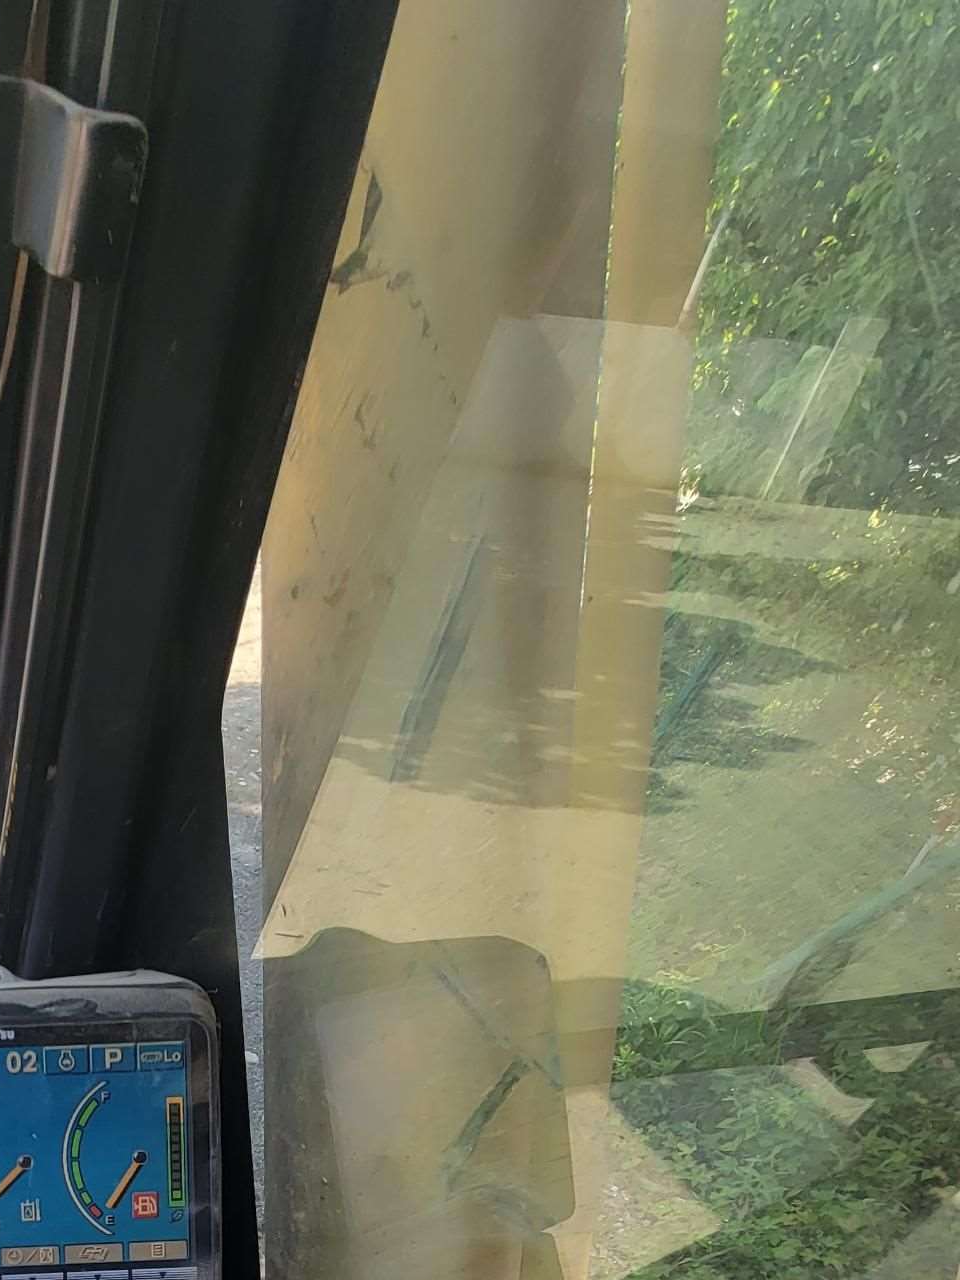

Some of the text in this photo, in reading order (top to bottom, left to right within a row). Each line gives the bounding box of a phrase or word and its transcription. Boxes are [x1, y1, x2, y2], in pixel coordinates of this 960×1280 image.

[6, 1051, 37, 1073] 02
[104, 1048, 122, 1069] P
[101, 1091, 112, 1103] F
[105, 1215, 115, 1226] E
